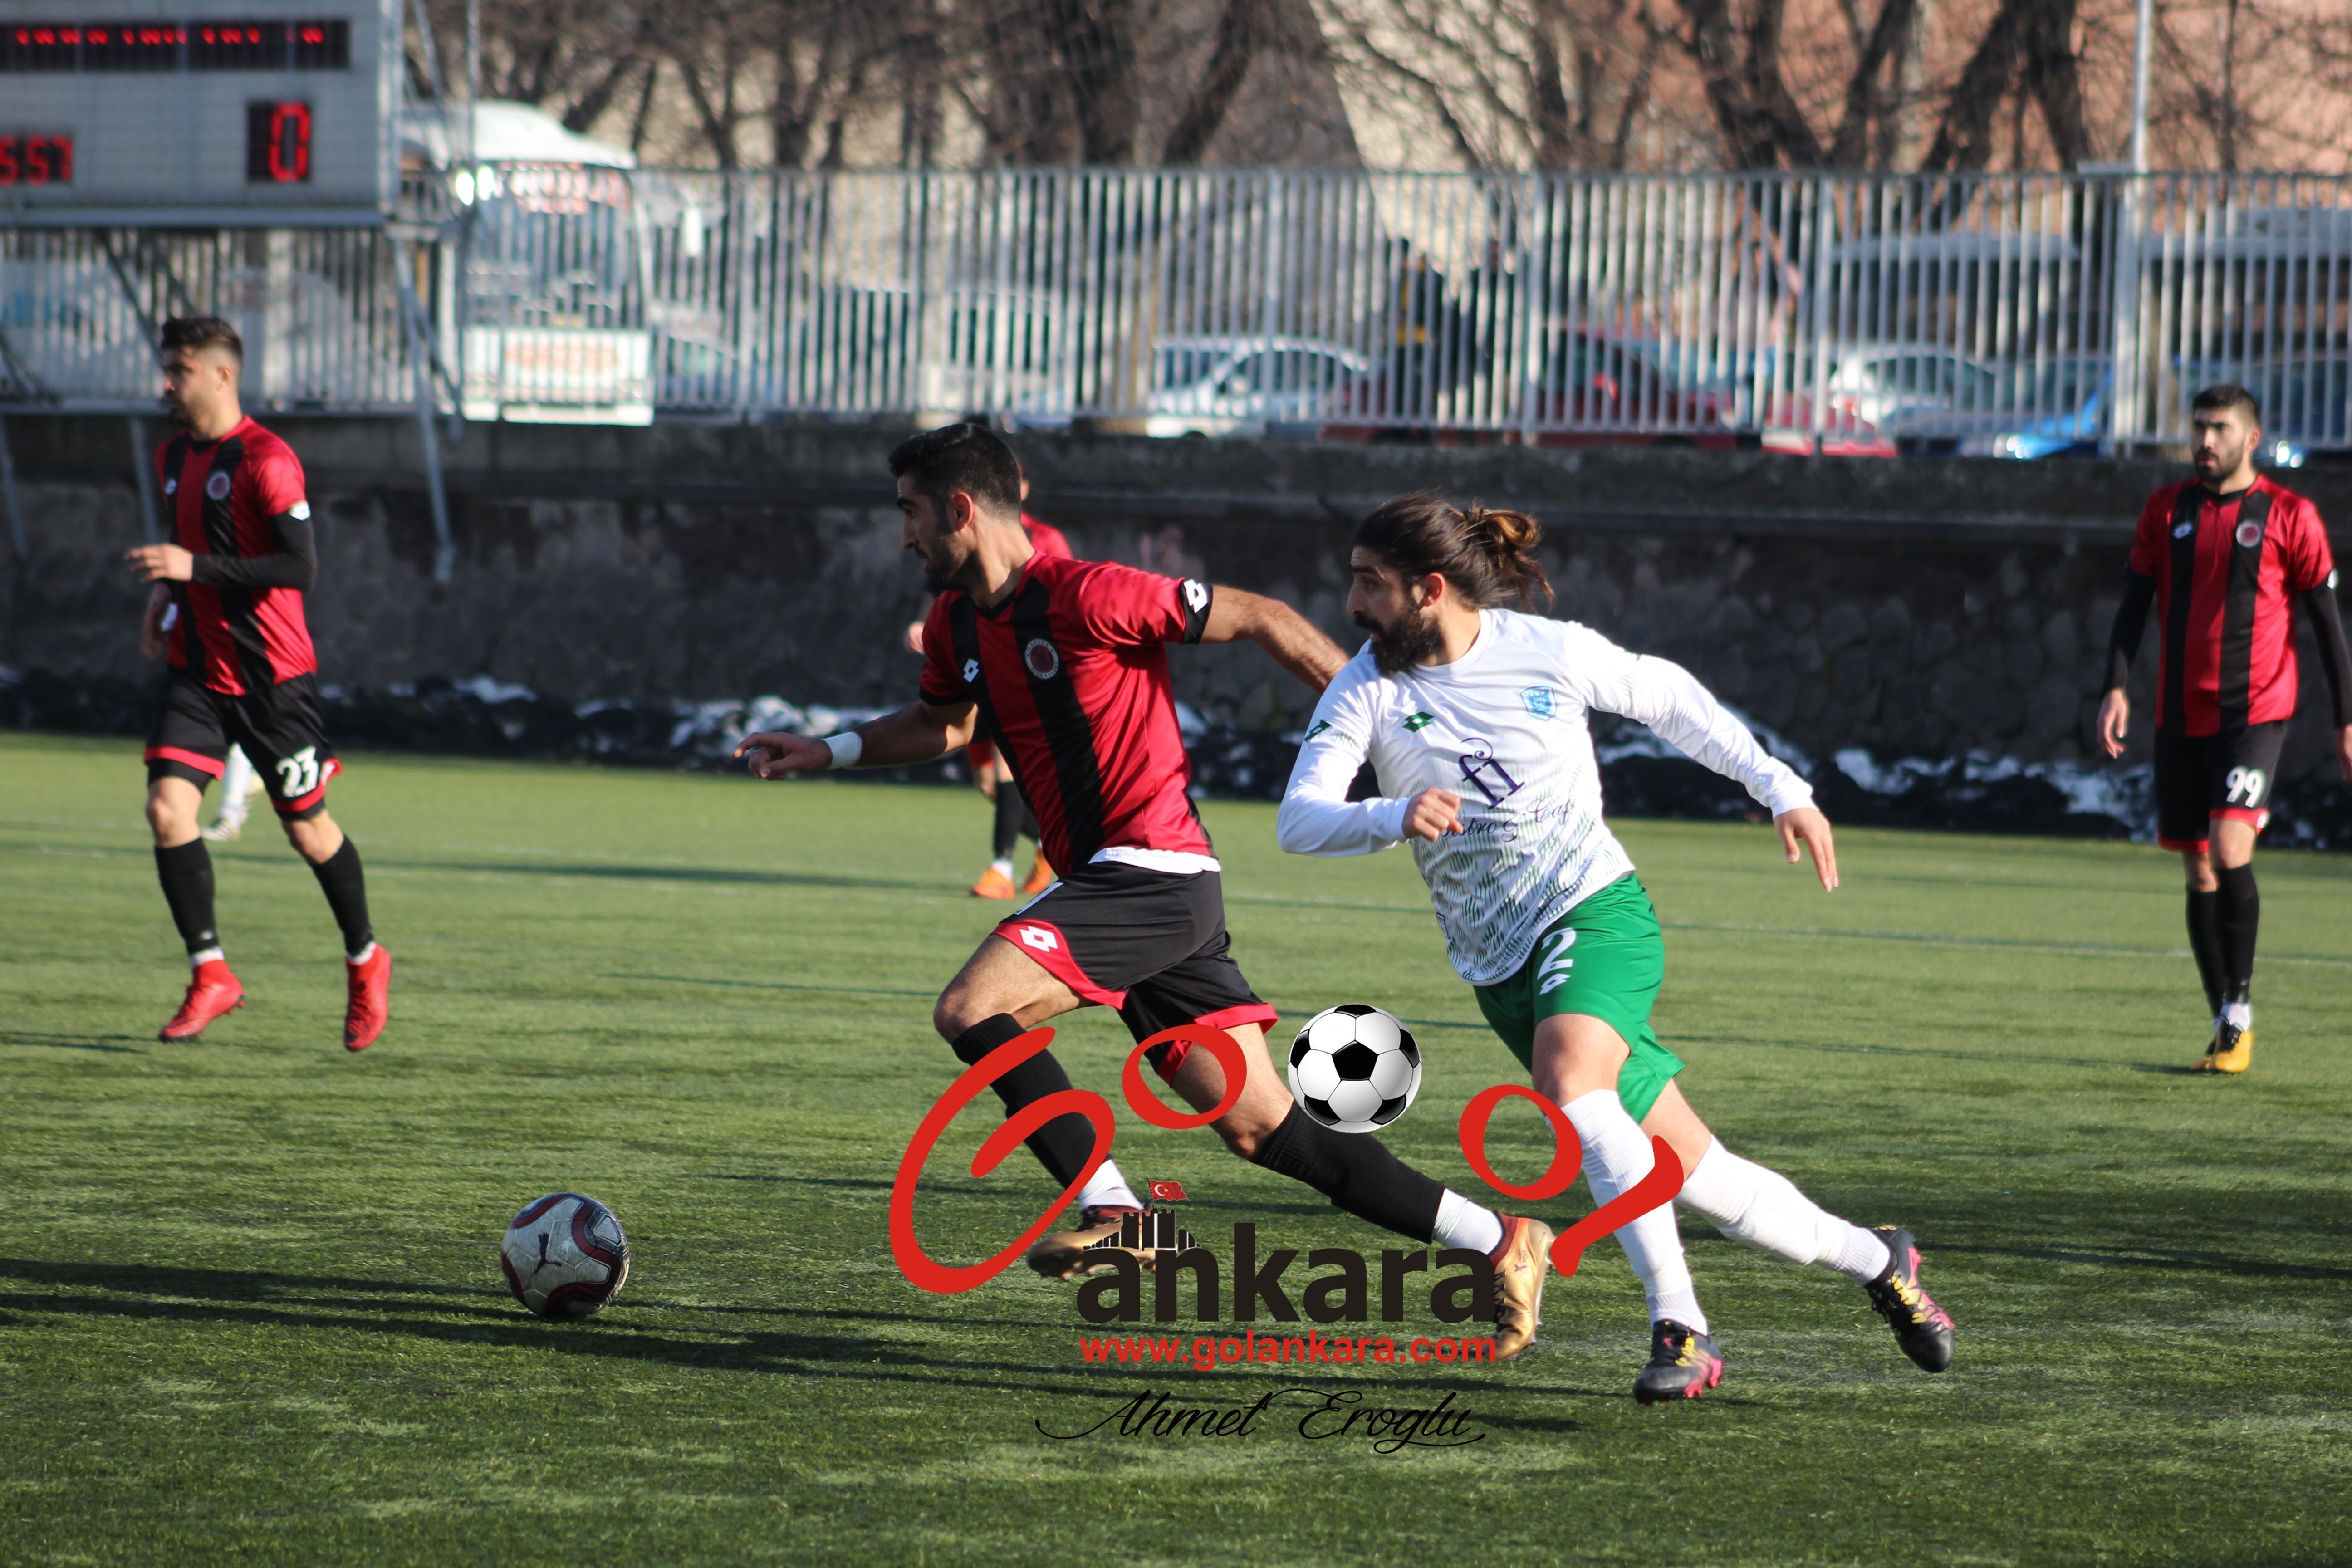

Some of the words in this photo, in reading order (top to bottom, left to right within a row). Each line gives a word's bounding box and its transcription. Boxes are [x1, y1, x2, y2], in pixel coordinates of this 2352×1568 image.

[268, 101, 311, 182] 0
[276, 745, 319, 797] 23
[2226, 765, 2266, 808] 99
[1537, 927, 1576, 980] 2
